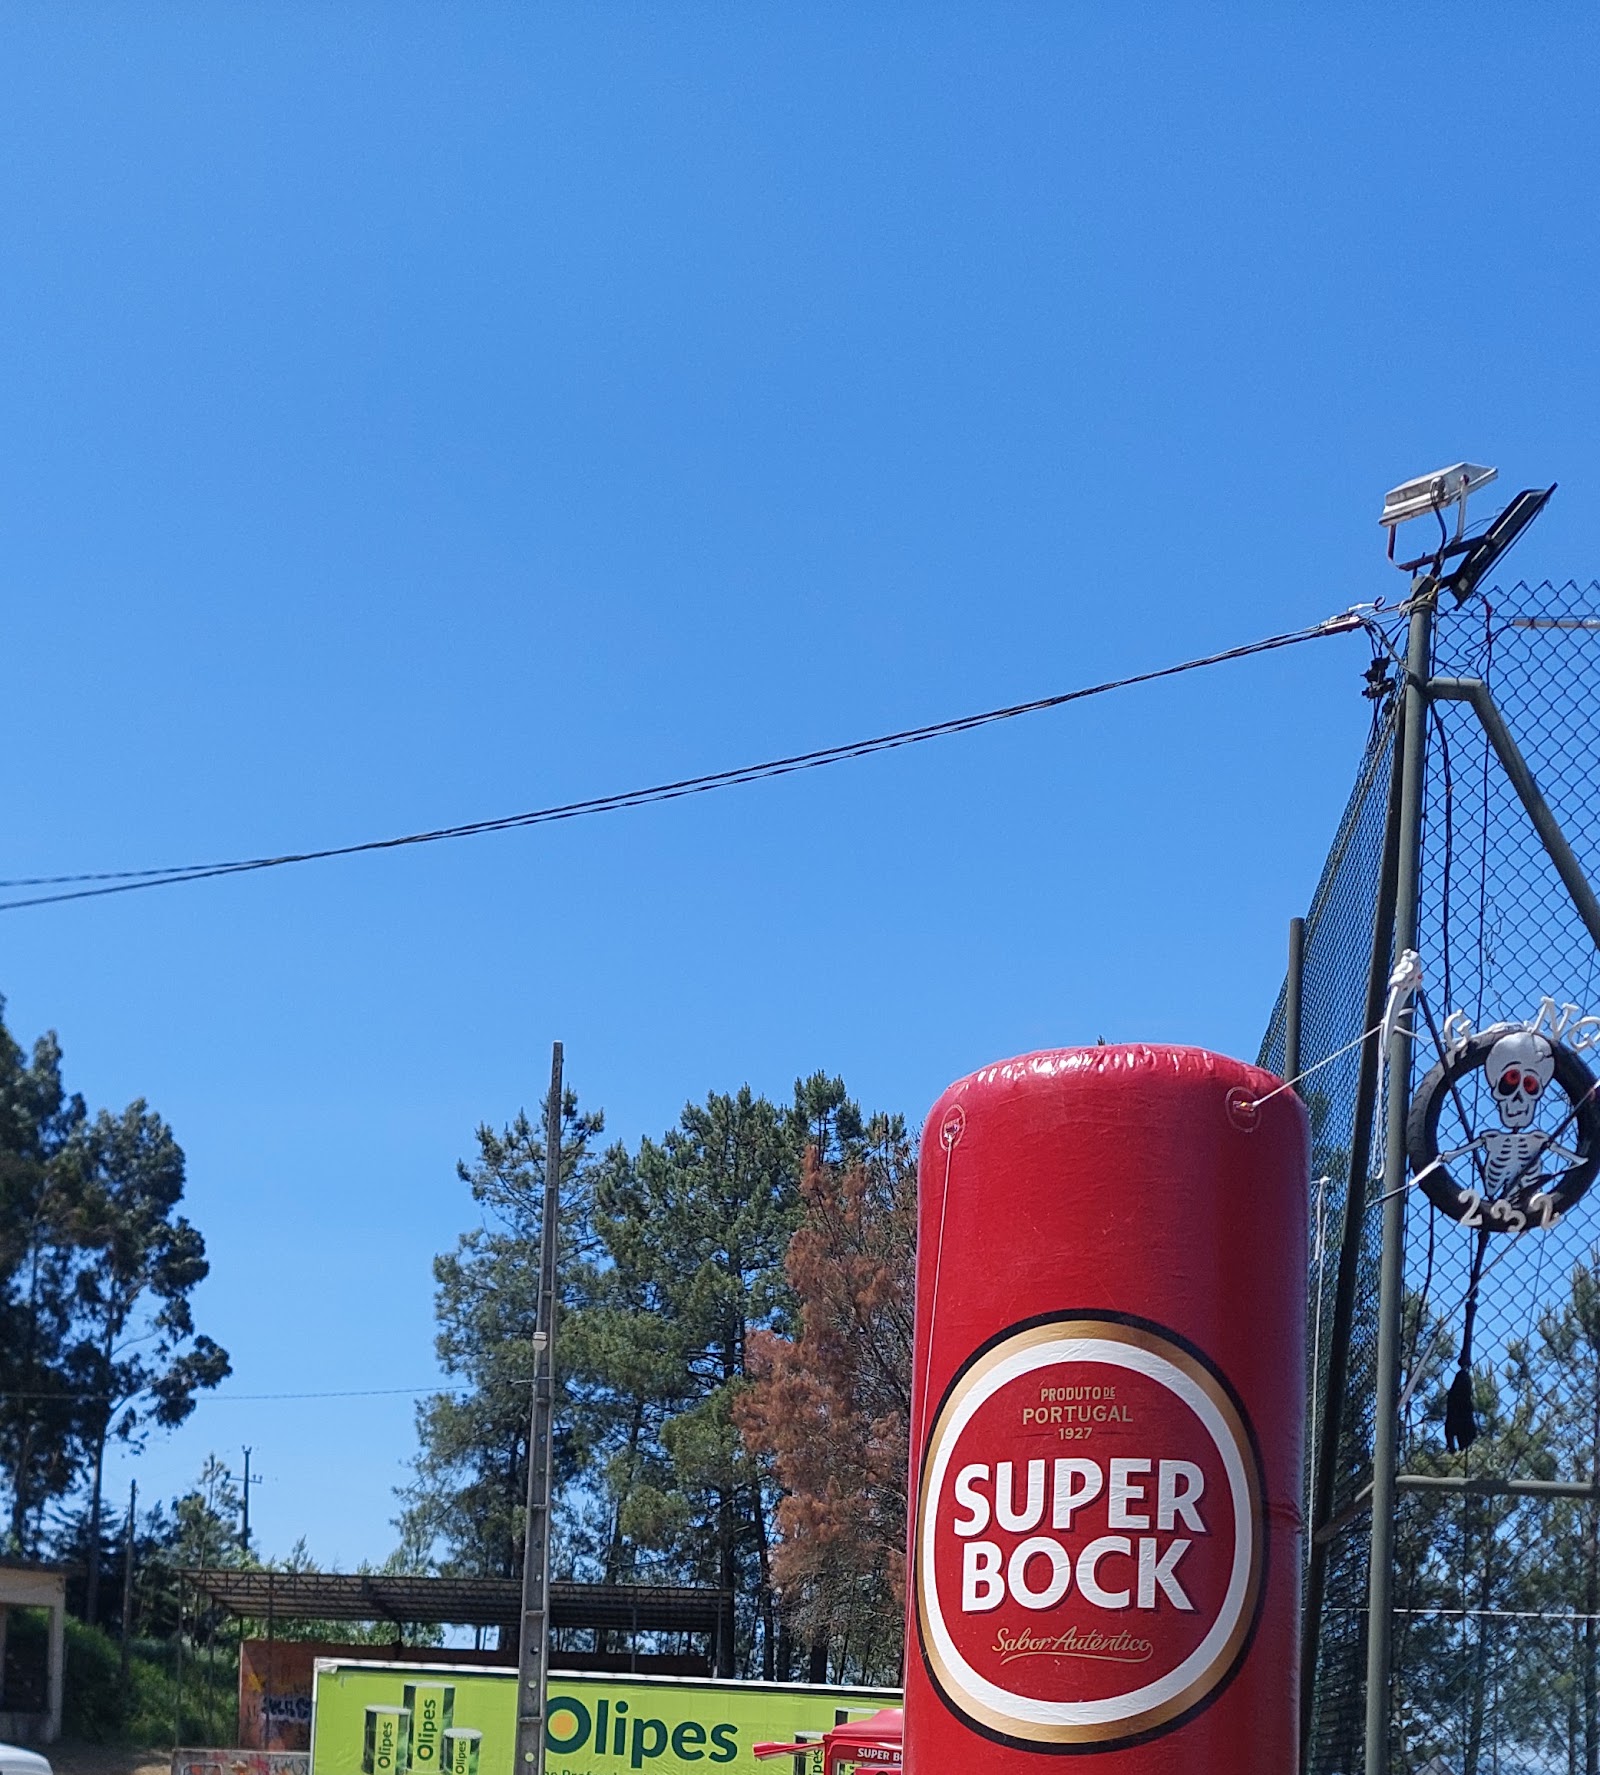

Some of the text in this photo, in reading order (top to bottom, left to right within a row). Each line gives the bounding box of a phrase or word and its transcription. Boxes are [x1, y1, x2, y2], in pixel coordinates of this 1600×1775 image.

[1040, 1386, 1116, 1402] PRODUTO DE
[1022, 1404, 1134, 1425] PORTUGAL
[1058, 1427, 1093, 1441] 1927
[953, 1457, 1208, 1538] SUPER
[961, 1535, 1197, 1613] BOCK
[992, 1626, 1052, 1654] Sabor
[378, 1721, 393, 1769] Olipes
[417, 1699, 438, 1761] Olipes
[545, 1696, 739, 1769] Olipes
[455, 1740, 468, 1775] Olipes
[857, 1747, 890, 1761] SUPER
